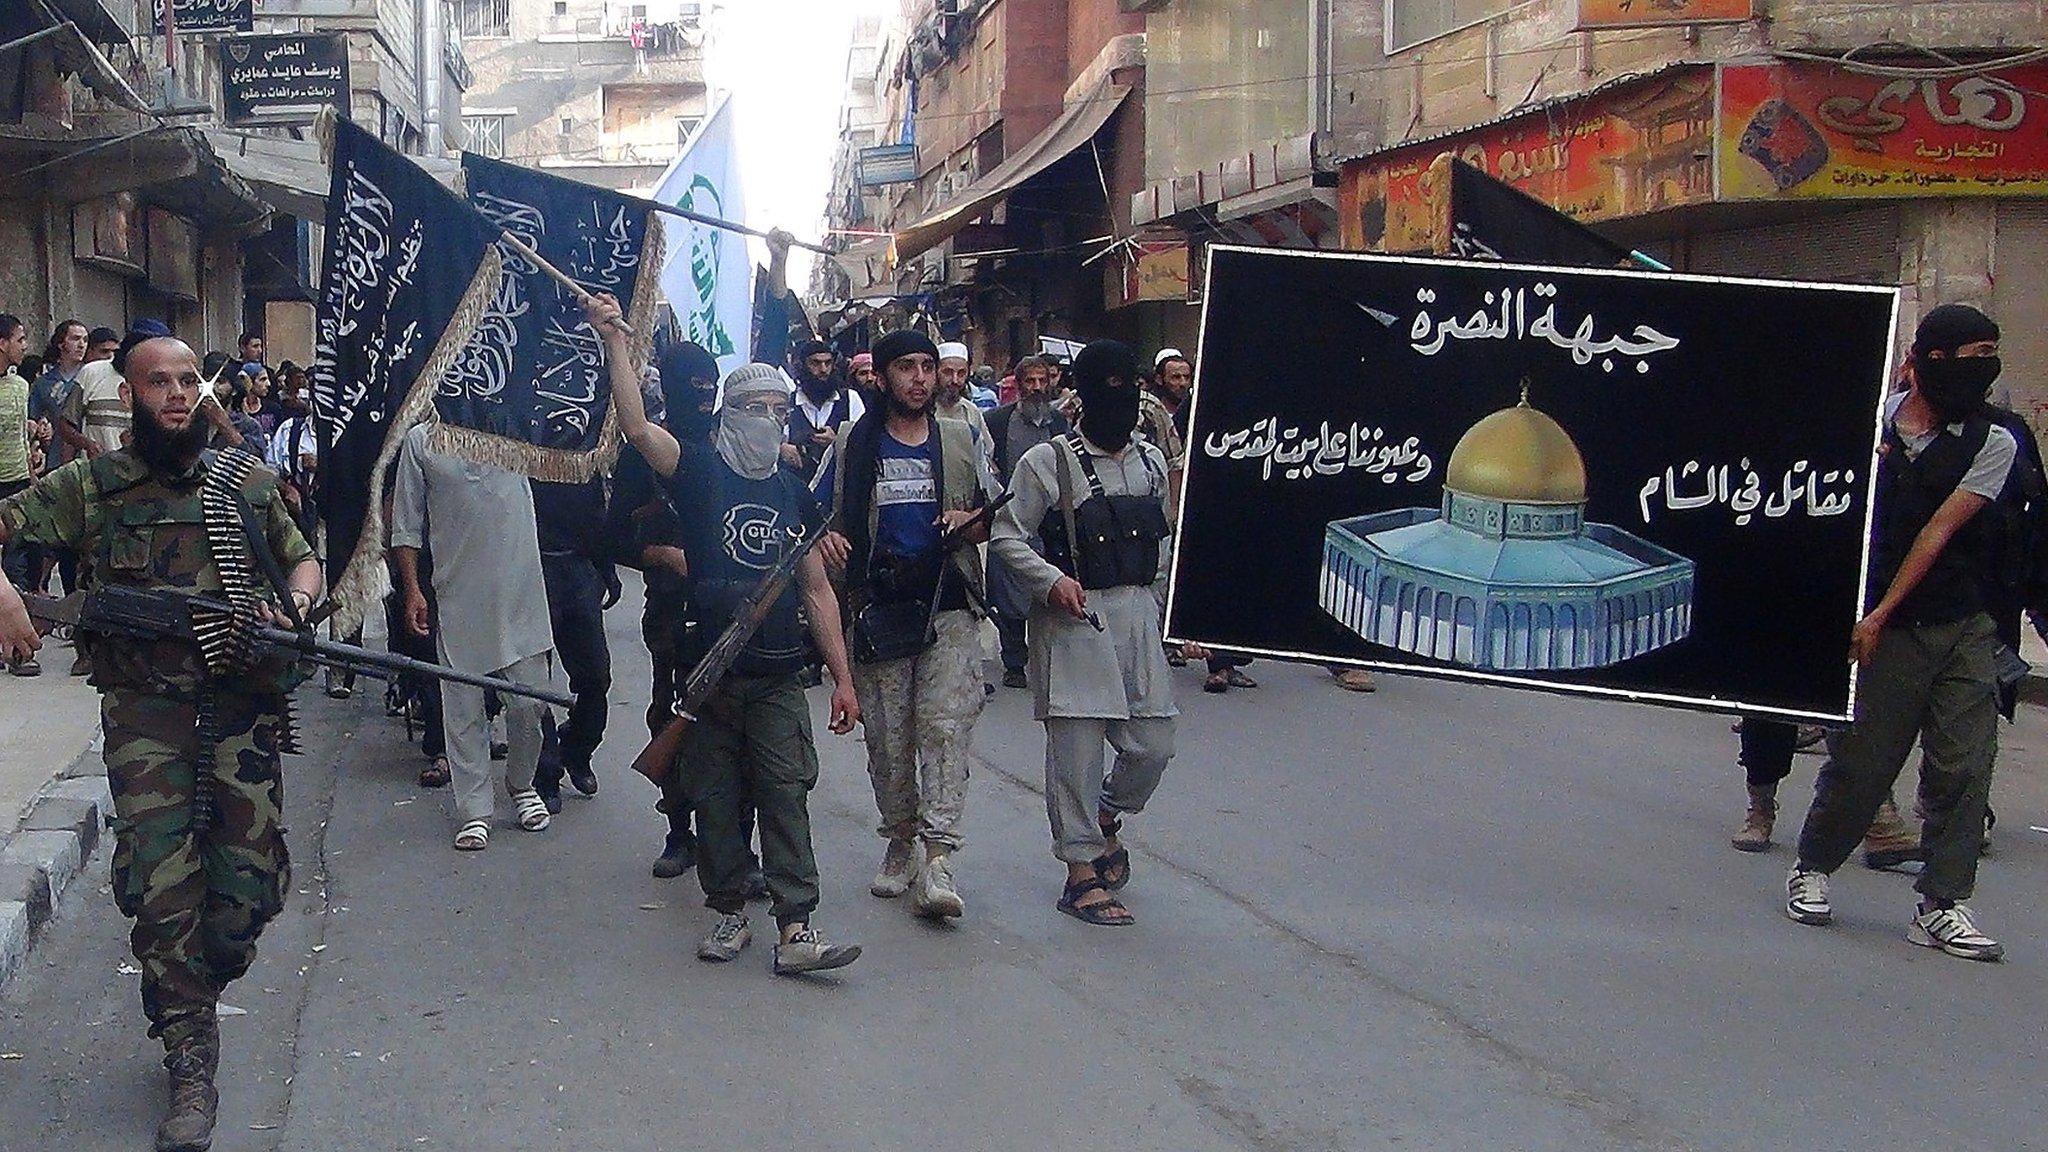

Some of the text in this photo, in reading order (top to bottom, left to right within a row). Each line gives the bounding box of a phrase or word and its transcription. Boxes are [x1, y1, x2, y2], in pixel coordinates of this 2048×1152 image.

[264, 42, 305, 62] المحامي
[271, 64, 302, 81] عايد
[304, 61, 342, 80] يوسف
[1915, 138, 2004, 162] التجارية
[1410, 282, 1681, 374] جبهة النصرة
[1204, 415, 1278, 481] المقدس
[1274, 426, 1320, 480] بيت
[1347, 421, 1433, 484] وعيوننا
[1639, 456, 1855, 526] نقاتل في الشام
